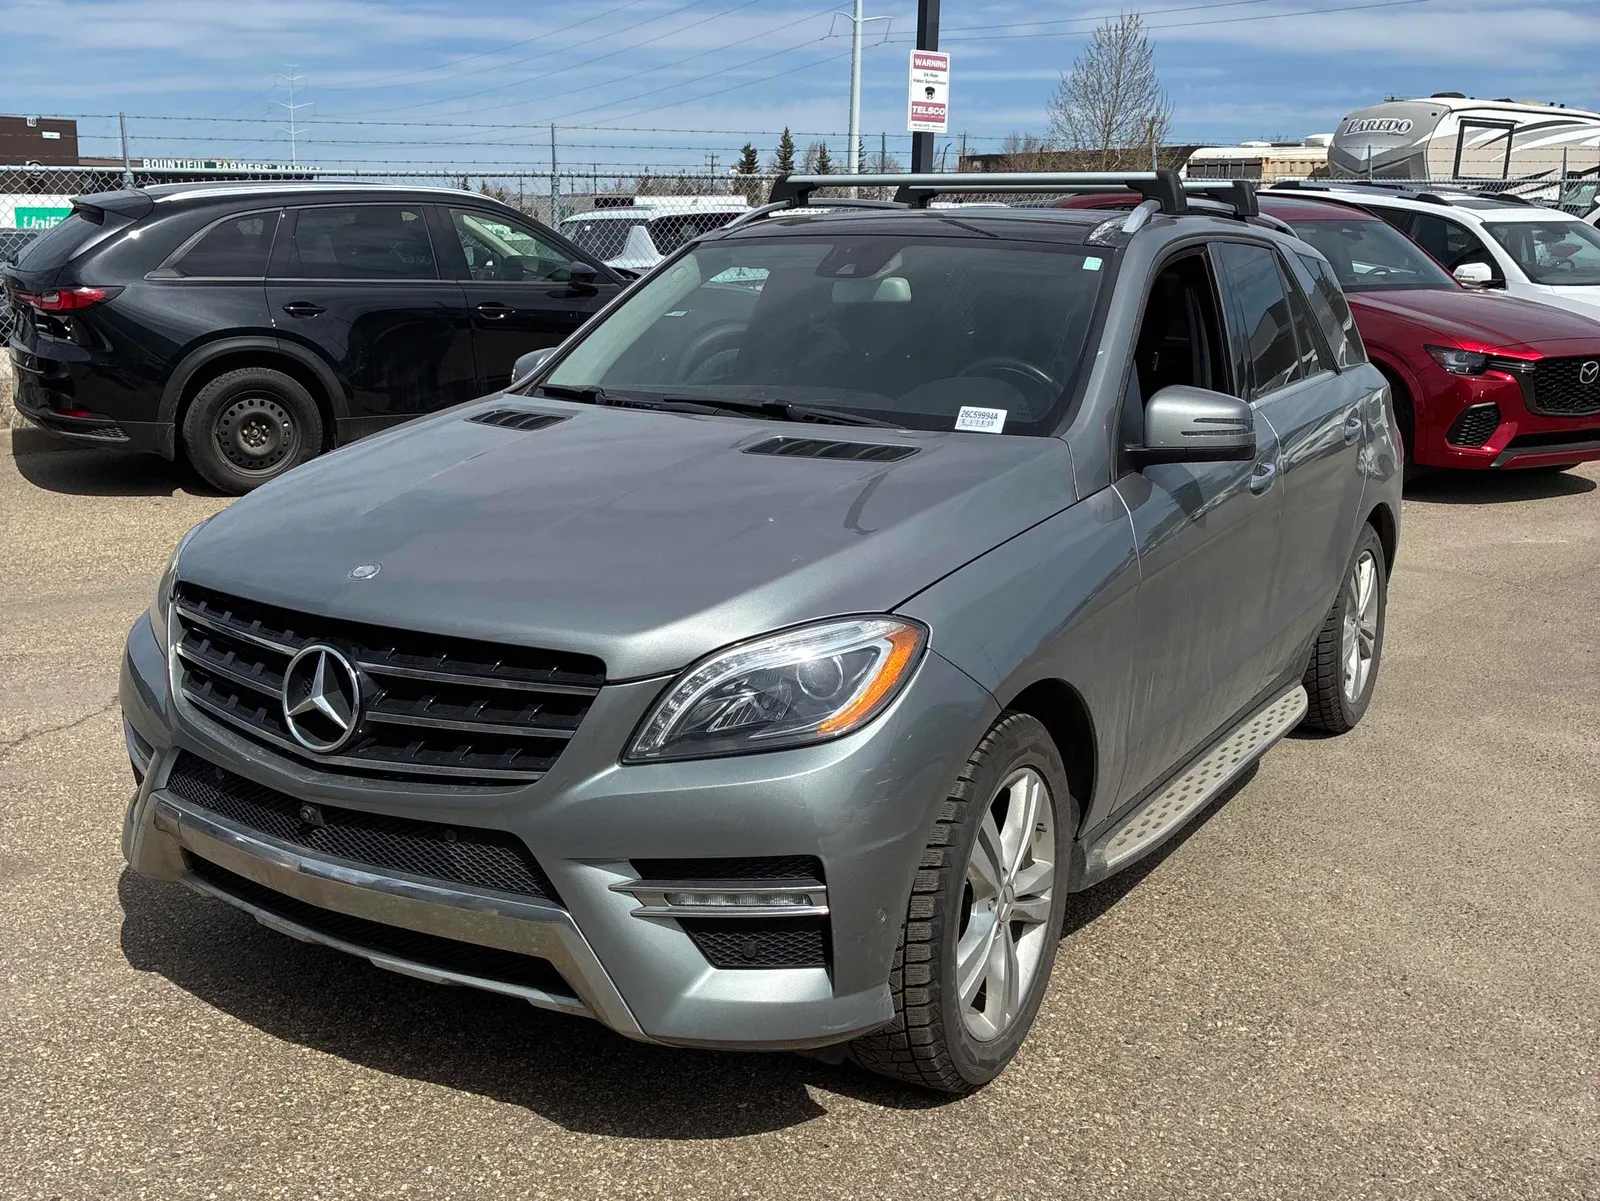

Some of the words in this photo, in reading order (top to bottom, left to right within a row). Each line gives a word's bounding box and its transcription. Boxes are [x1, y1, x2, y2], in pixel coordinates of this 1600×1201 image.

[914, 58, 947, 69] WARNING
[912, 105, 946, 115] TELSCO
[1343, 118, 1413, 136] LAREDO
[23, 216, 63, 229] UniF
